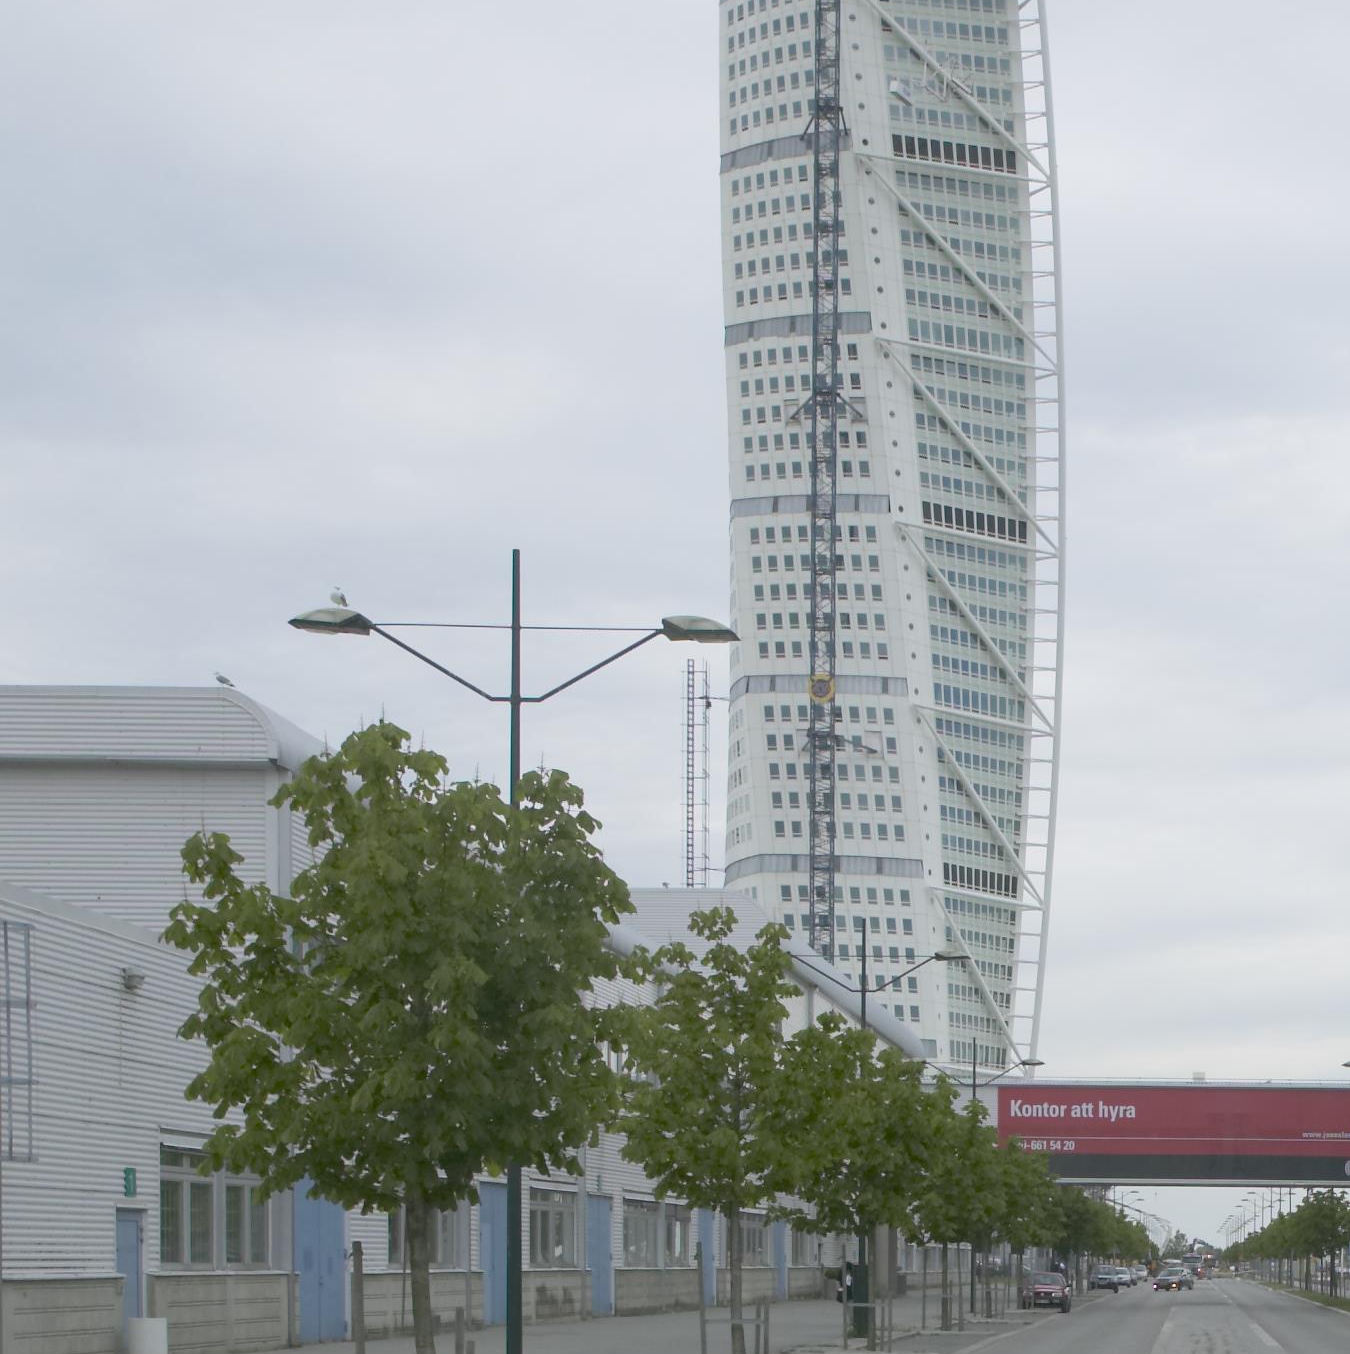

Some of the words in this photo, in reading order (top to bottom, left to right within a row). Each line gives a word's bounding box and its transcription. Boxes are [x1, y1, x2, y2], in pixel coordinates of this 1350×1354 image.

[1010, 1099, 1067, 1118] Kontor
[1071, 1102, 1094, 1118] att
[1098, 1100, 1136, 1122] hyra
[1050, 1140, 1061, 1150] 54
[1063, 1140, 1075, 1151] 20
